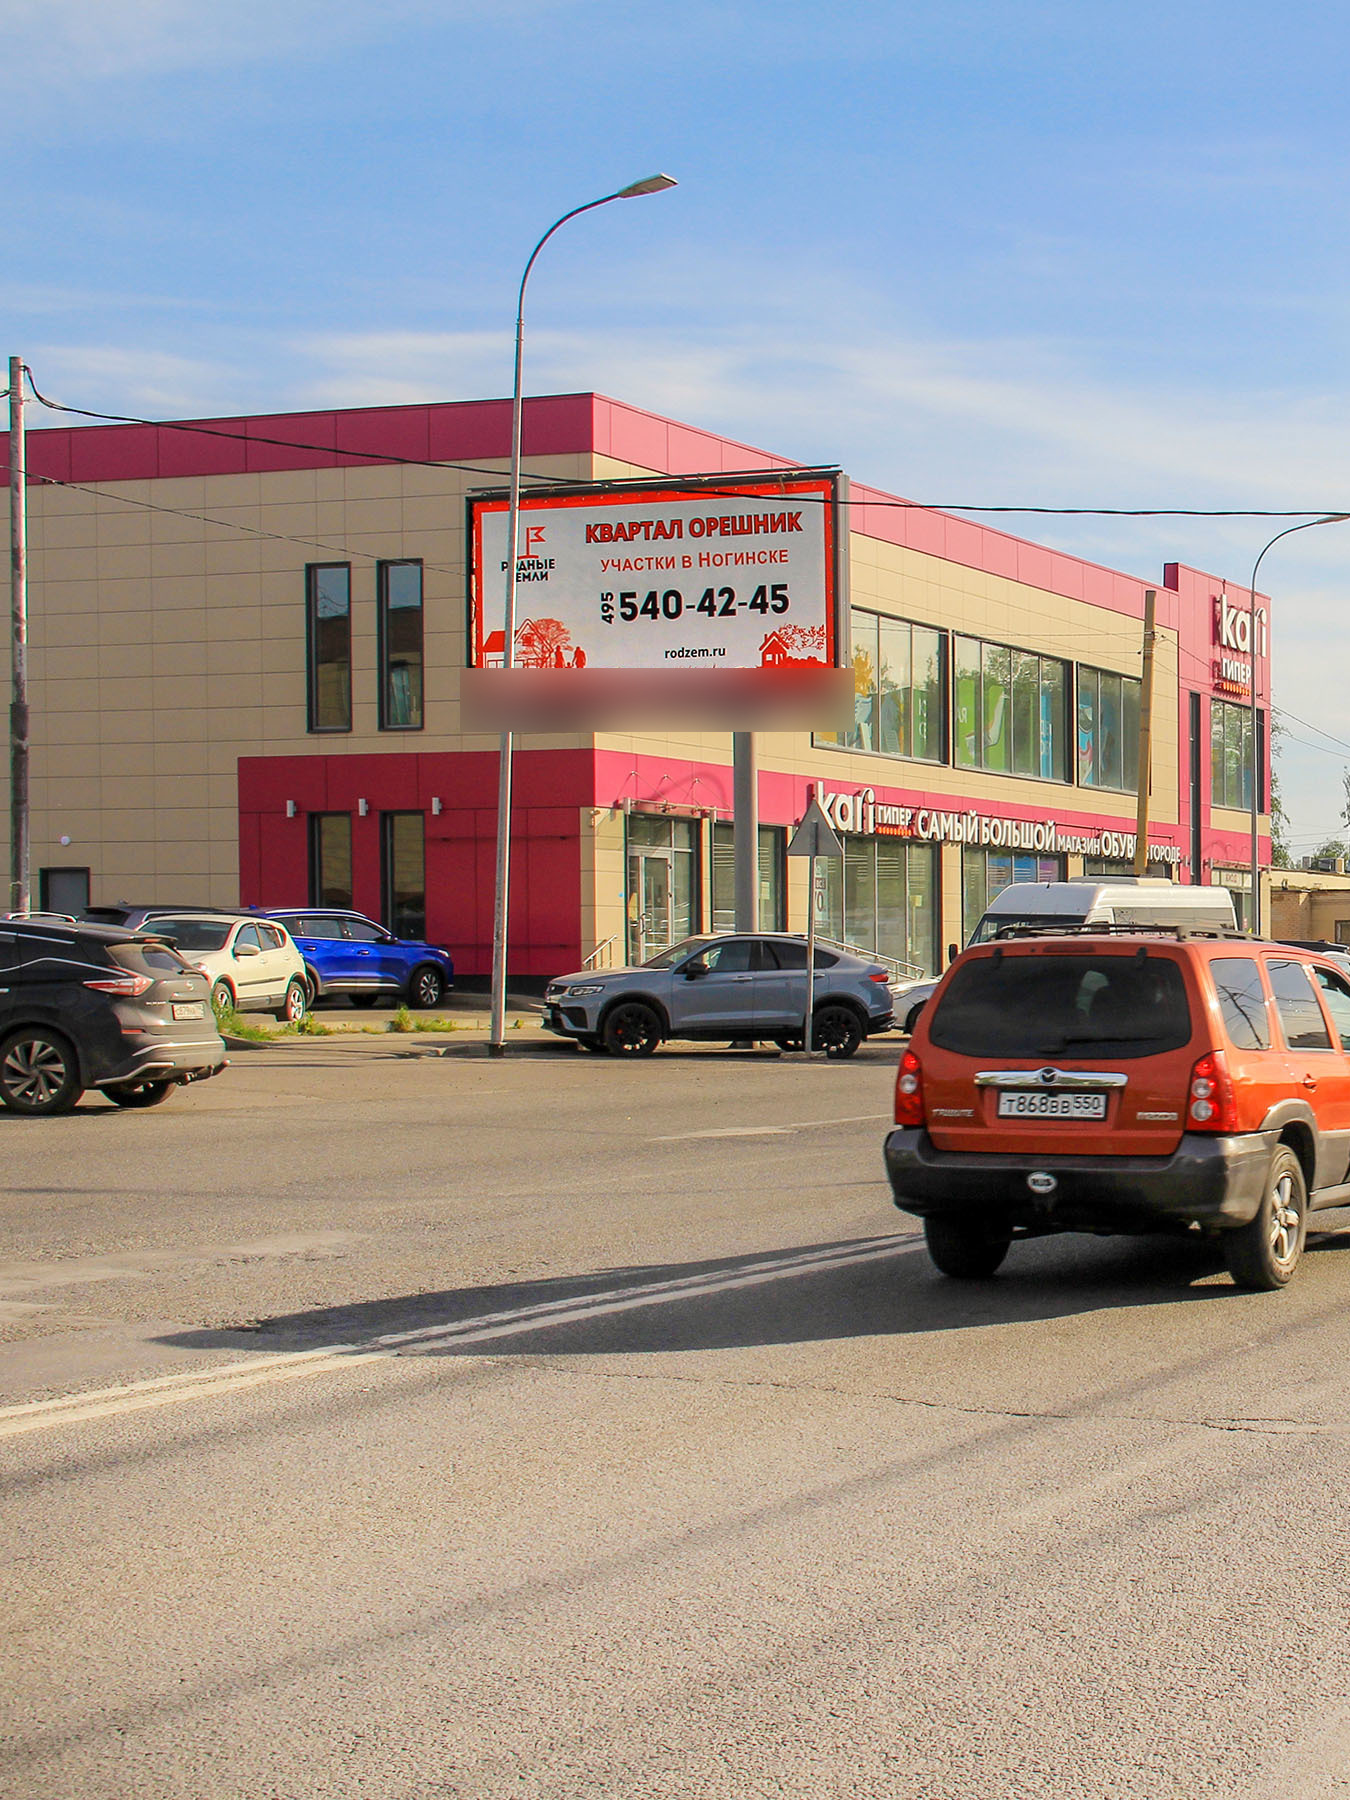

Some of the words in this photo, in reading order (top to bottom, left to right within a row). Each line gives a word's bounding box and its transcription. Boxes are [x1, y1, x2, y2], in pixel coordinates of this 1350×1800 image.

[585, 519, 683, 544] КВАРТАЛ
[688, 511, 803, 538] ОРЕШНИК
[501, 558, 555, 572] РДНЫЕ
[515, 571, 549, 583] ЕМЛИ
[600, 591, 614, 624] 495
[619, 583, 790, 622] 540-42-45
[664, 647, 726, 659] rodzem.ru
[1221, 657, 1252, 684] ГИПЕР
[815, 781, 875, 834] kari
[876, 804, 912, 826] ГИПЕР
[917, 809, 979, 844] САМЫЙ
[980, 818, 1056, 852] БОЛЬШОЙ
[1057, 834, 1100, 855] МАГАЗИН
[1101, 830, 1137, 858] ОБУВ
[1149, 846, 1181, 864] ГОРОДЕ
[1006, 1095, 1070, 1114] Т868ВВ
[1073, 1095, 1101, 1110] 550
